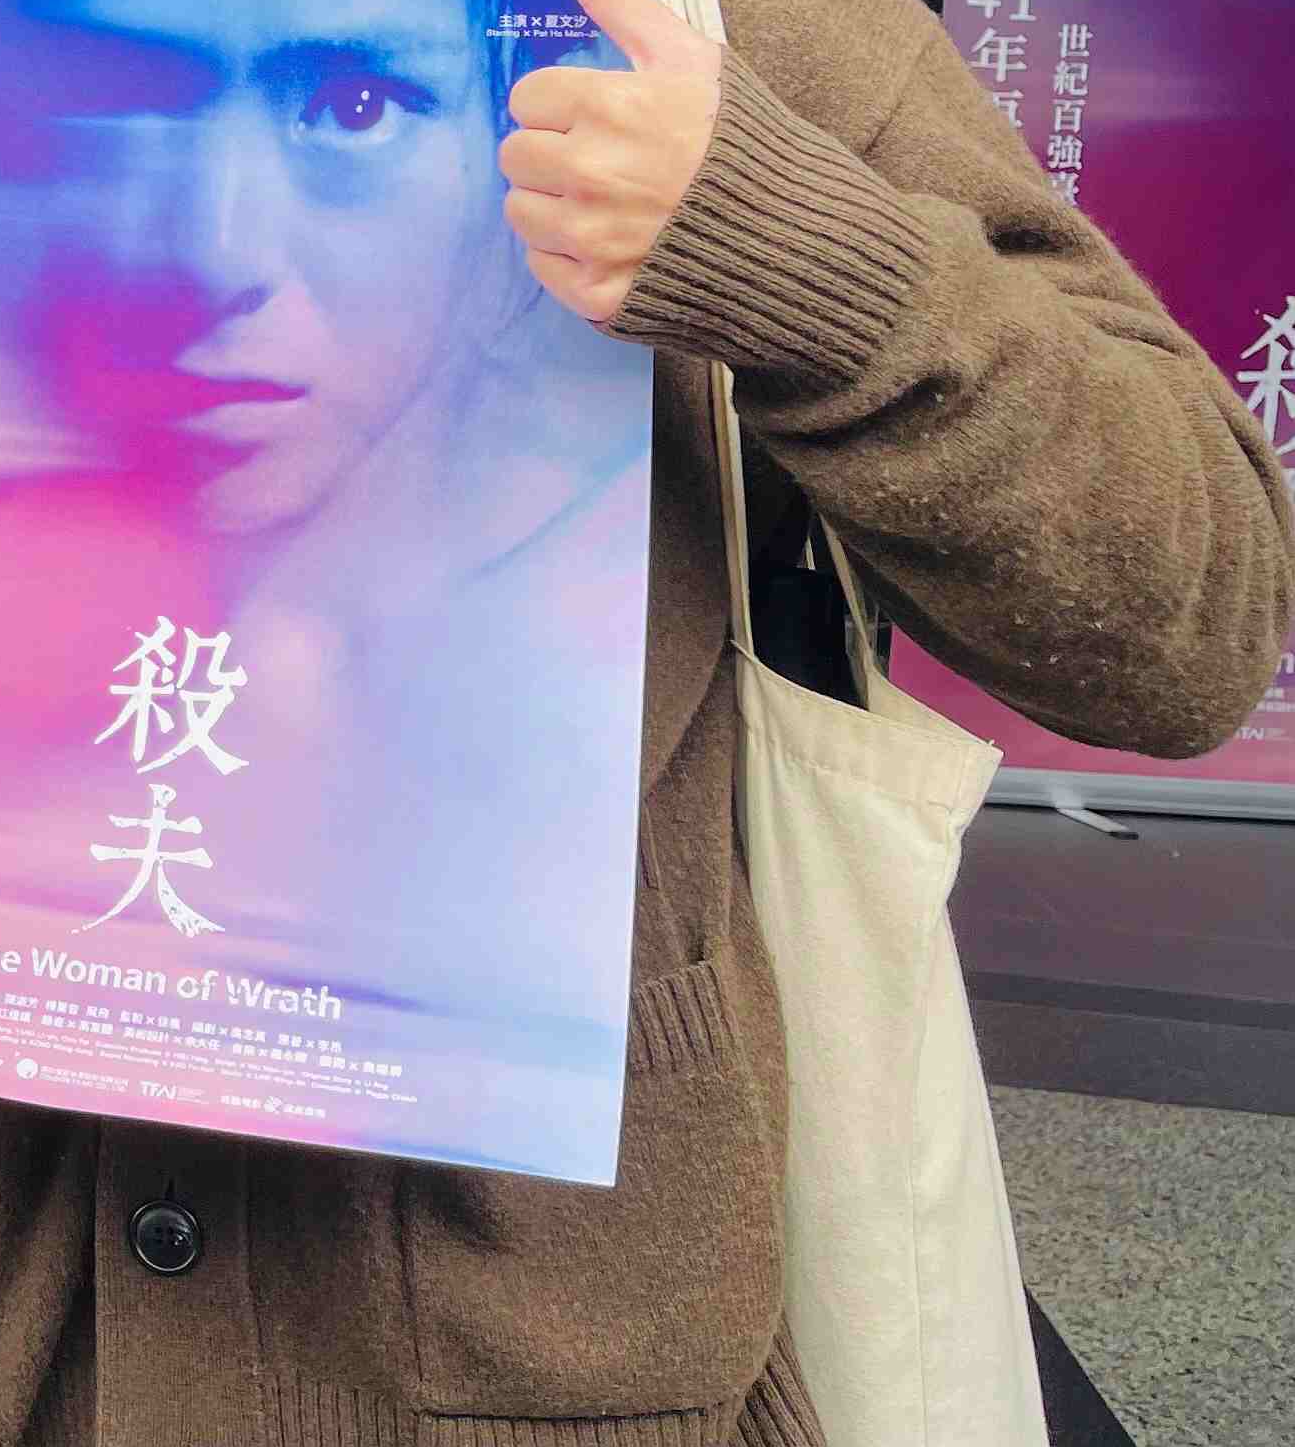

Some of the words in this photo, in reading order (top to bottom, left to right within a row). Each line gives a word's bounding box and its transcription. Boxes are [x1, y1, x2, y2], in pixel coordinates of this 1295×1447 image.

[71, 615, 250, 939] 殺夫
[31, 947, 168, 995] Woman
[176, 970, 219, 1001] of
[225, 975, 342, 1021] Wrath
